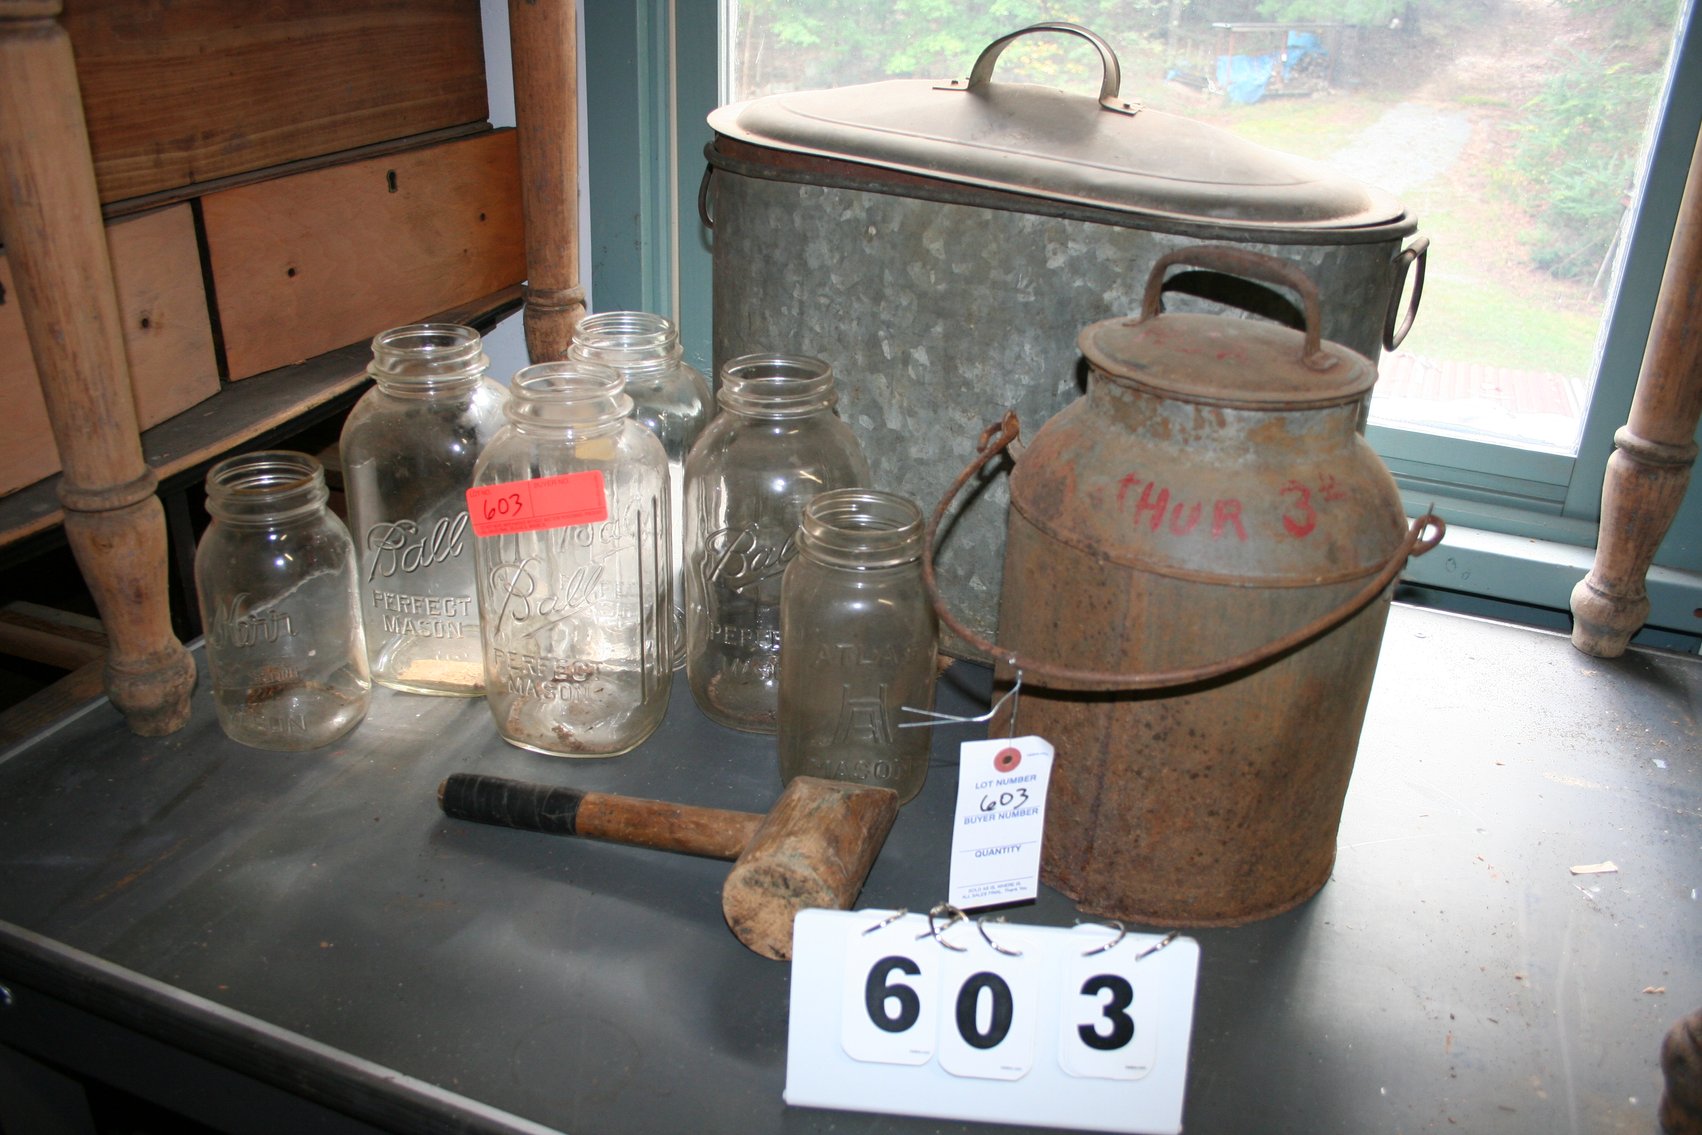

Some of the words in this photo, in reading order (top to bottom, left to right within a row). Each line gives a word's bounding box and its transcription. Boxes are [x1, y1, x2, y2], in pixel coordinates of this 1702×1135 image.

[483, 493, 523, 520] 603
[368, 511, 470, 583] Ball
[372, 589, 472, 617] PERFECT
[490, 557, 604, 637] Ball
[382, 613, 465, 639] MASON
[493, 647, 603, 682] PERFECT
[507, 675, 592, 701] MASON
[975, 780, 993, 790] LOT
[996, 774, 1037, 786] NUMBER
[980, 788, 1029, 812] 603
[964, 812, 996, 825] BUYER
[998, 807, 1039, 820] NUMBER
[974, 845, 1022, 858] QUANTITY
